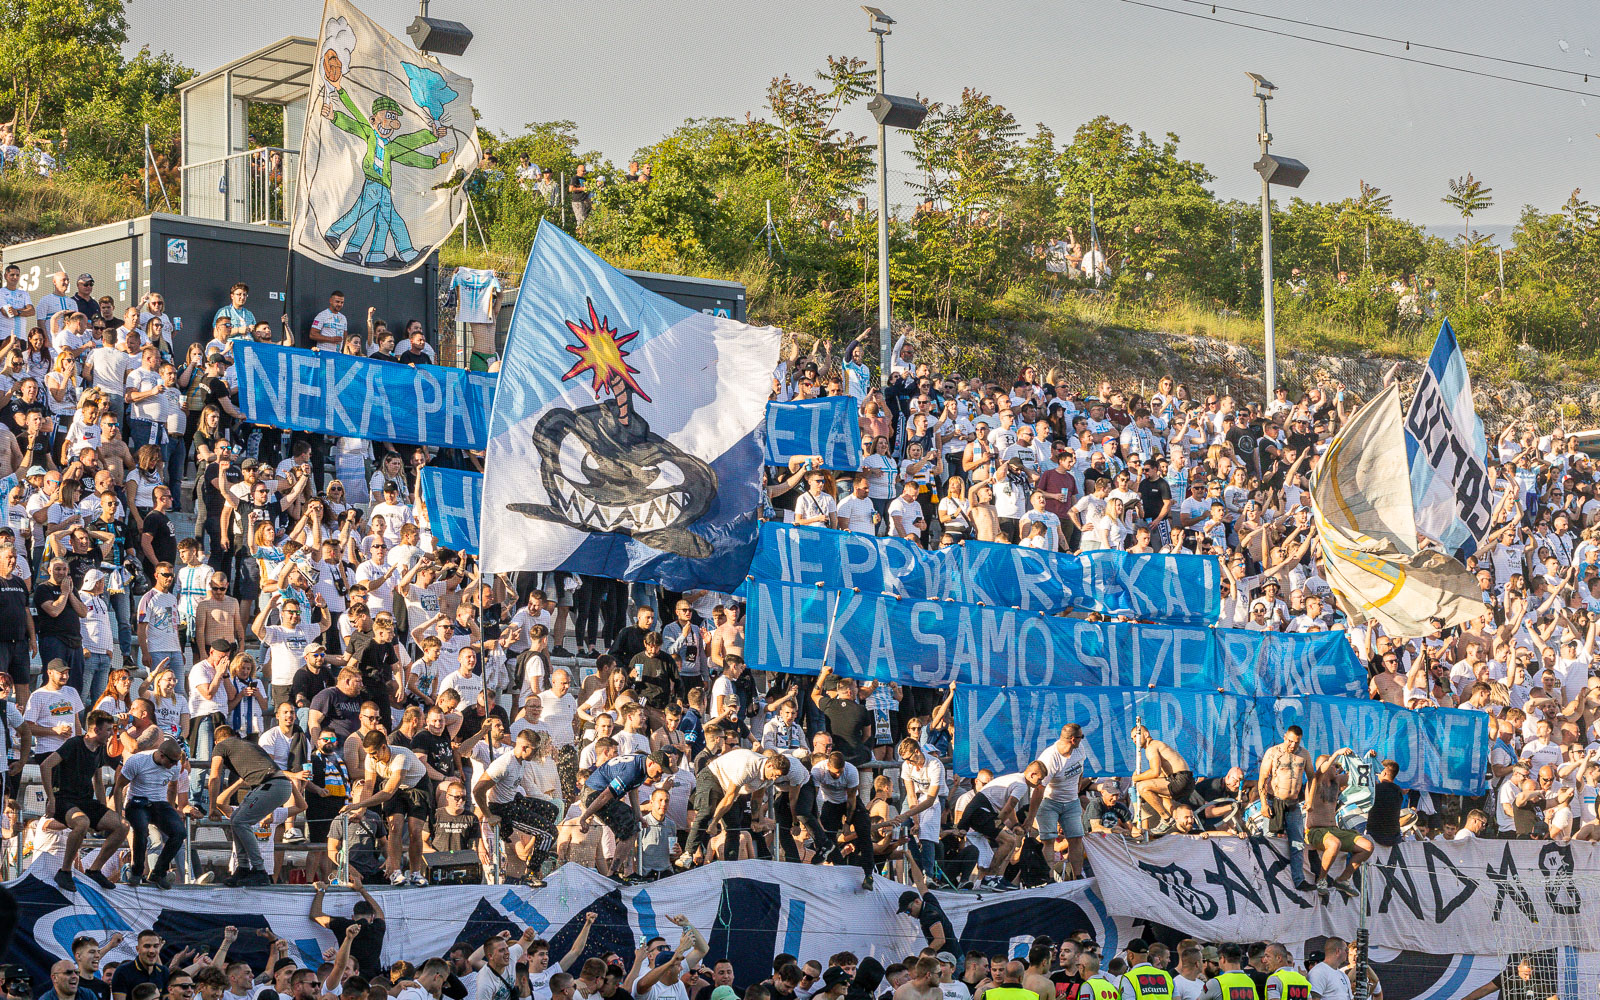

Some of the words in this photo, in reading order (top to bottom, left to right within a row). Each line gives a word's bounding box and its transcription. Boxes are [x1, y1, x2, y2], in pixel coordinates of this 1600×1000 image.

[244, 347, 396, 439] NEKA
[414, 369, 497, 444] PAT
[768, 402, 857, 468] ETA
[839, 535, 996, 606] PRVAK
[758, 583, 898, 678] NEKA
[911, 601, 1055, 688] SAMO
